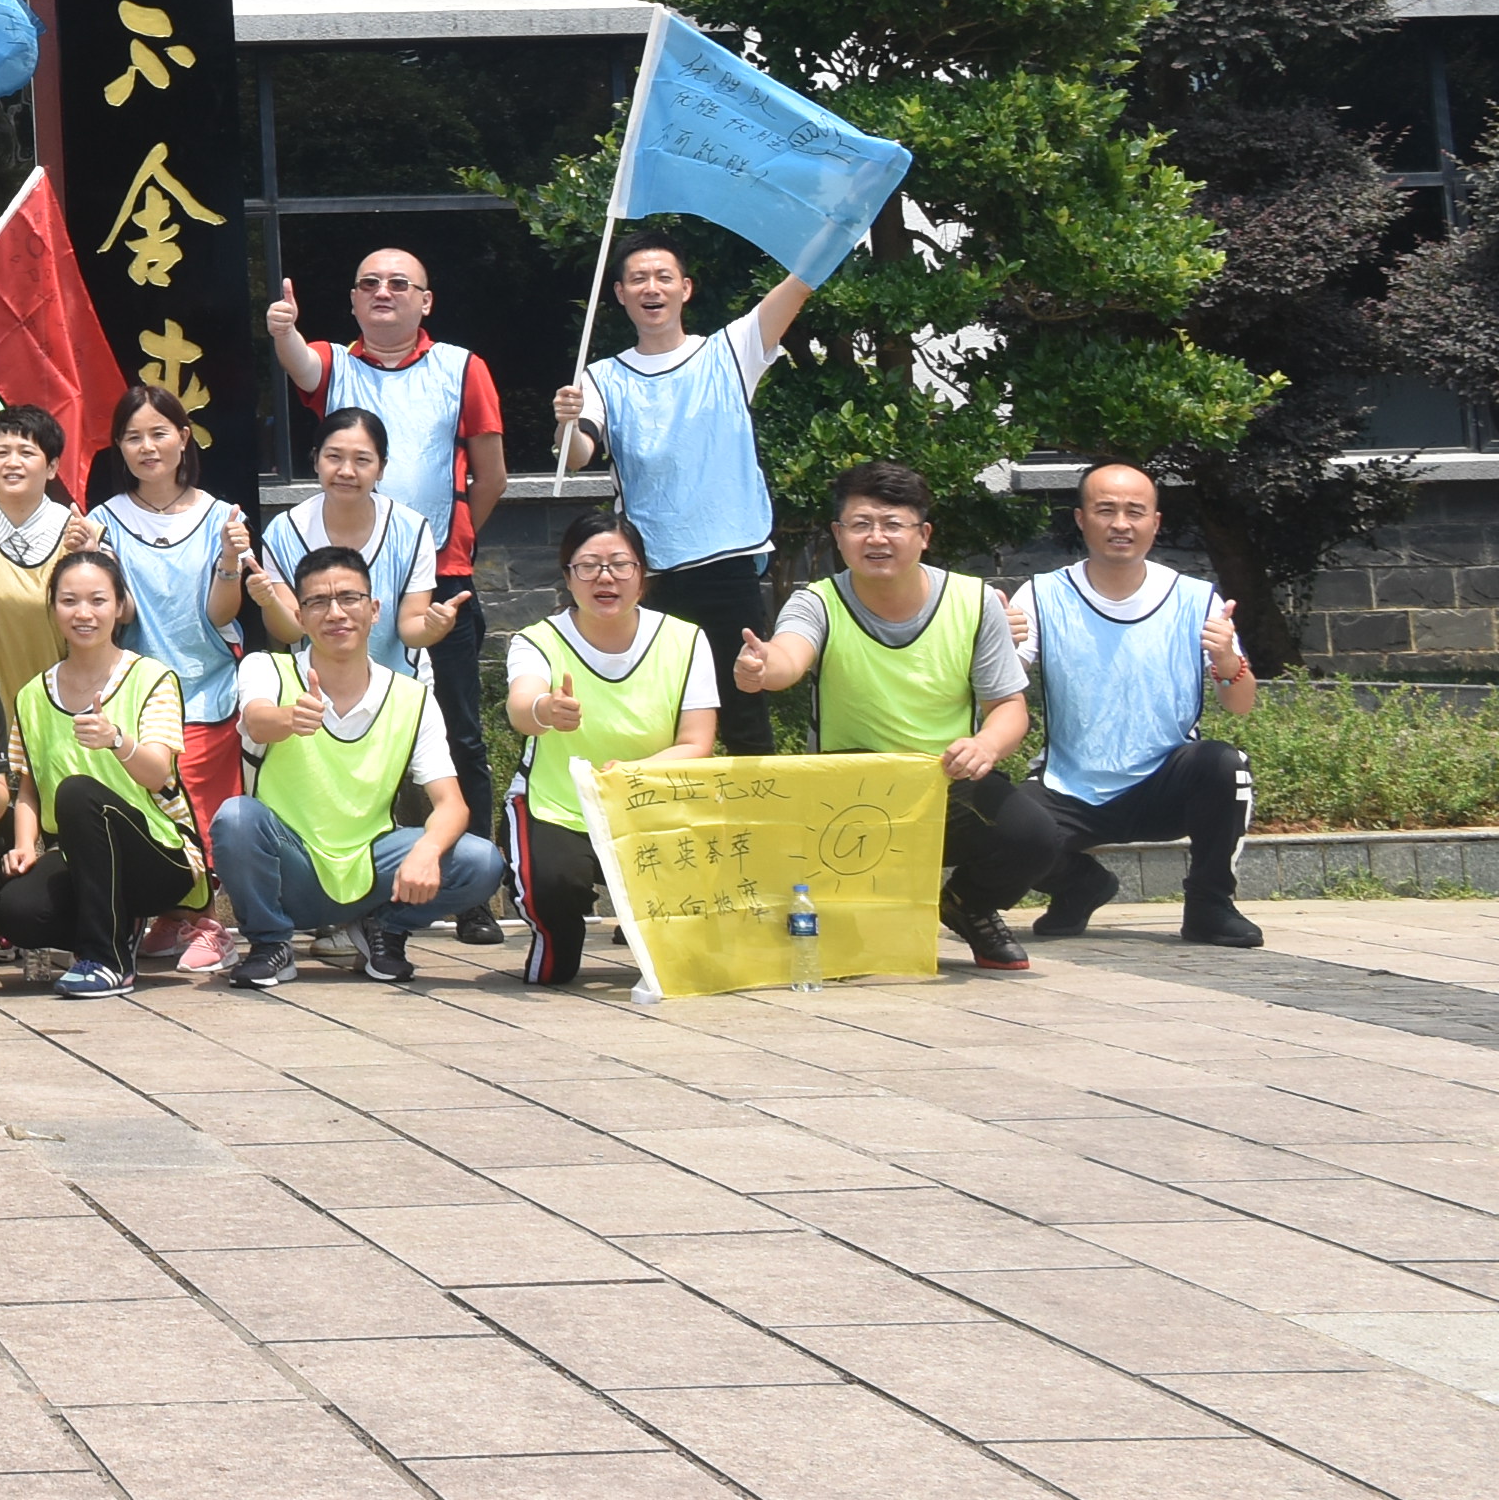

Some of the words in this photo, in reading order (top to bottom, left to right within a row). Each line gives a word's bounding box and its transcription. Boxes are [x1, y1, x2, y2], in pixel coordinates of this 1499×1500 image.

[678, 53, 778, 120] 优胜队
[624, 766, 791, 811] 盖世无双
[633, 829, 754, 882] 群英荟萃
